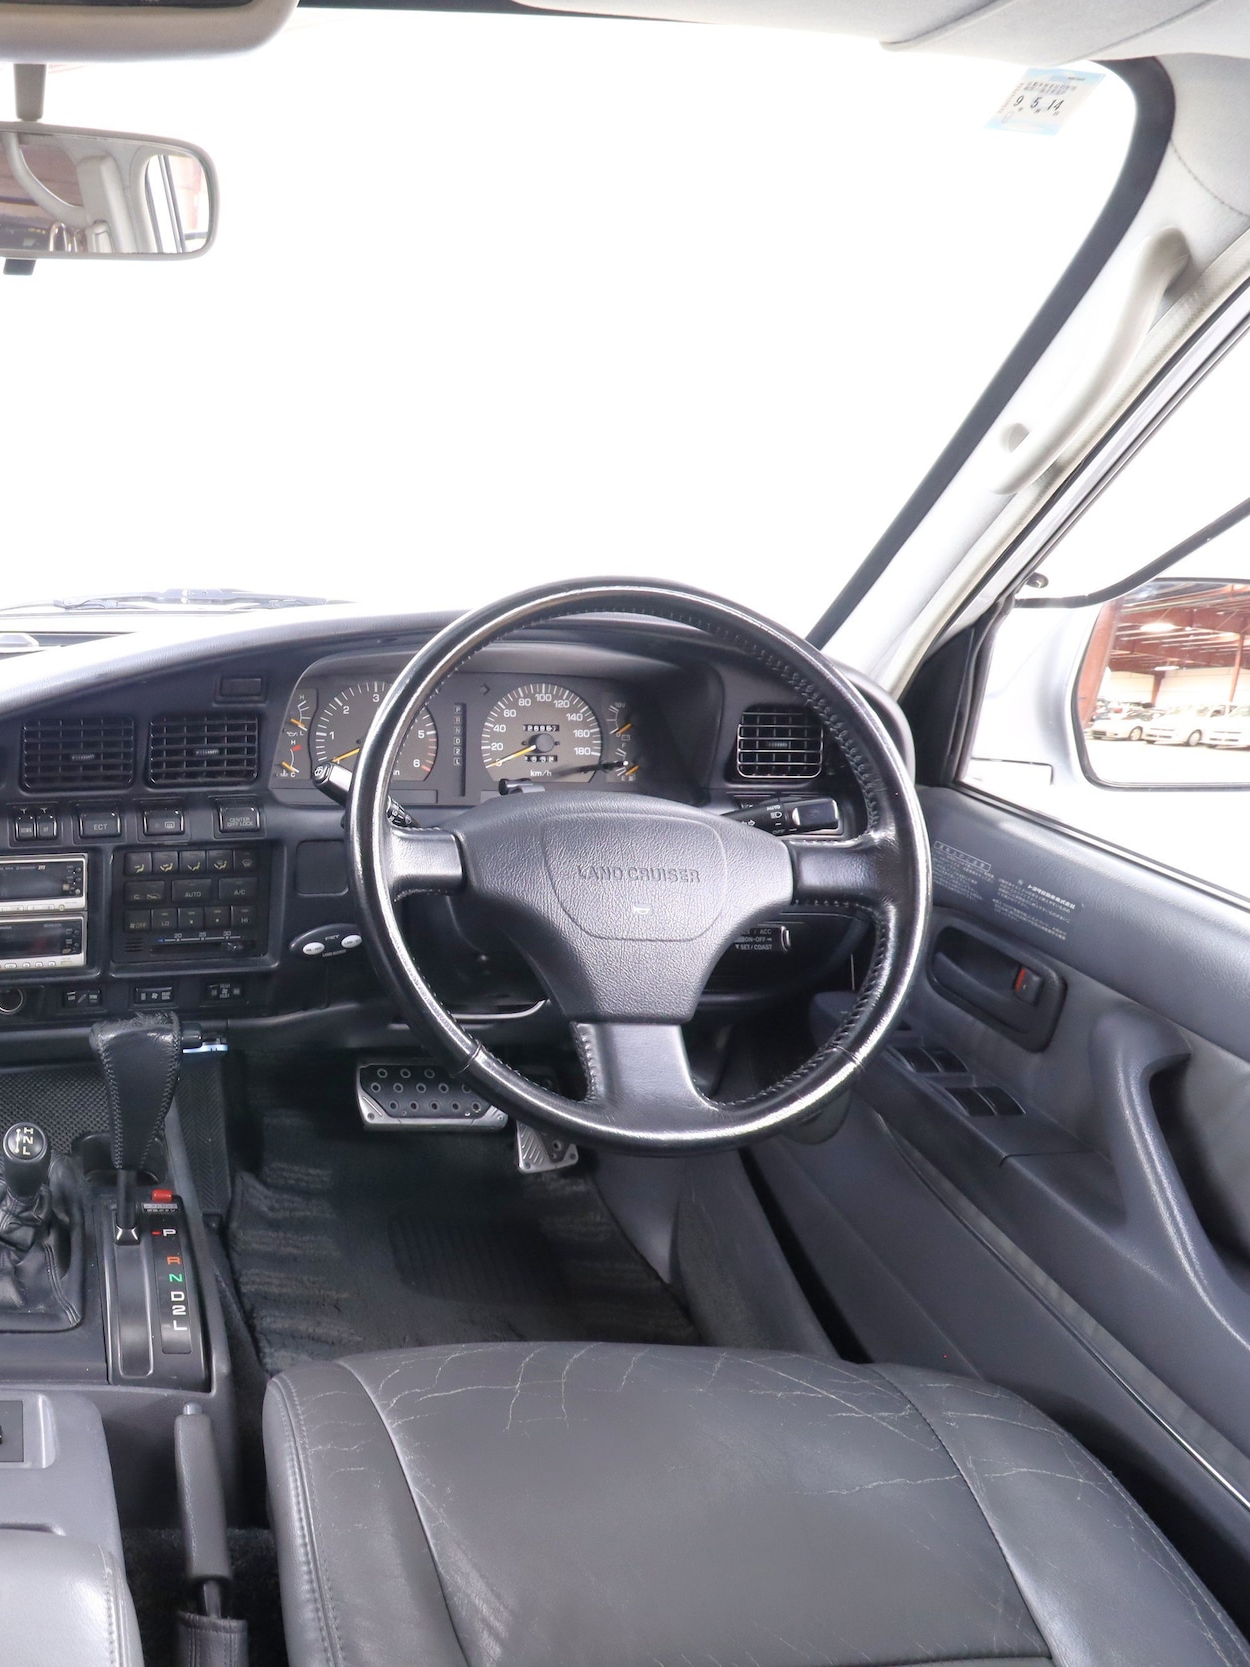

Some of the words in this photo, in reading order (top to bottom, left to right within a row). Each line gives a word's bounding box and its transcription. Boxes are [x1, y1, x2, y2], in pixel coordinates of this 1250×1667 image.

[1013, 95, 1024, 107] 9
[1030, 97, 1042, 109] 5
[1047, 99, 1064, 111] 14
[373, 693, 380, 702] 3
[535, 694, 552, 702] 100
[518, 699, 532, 707] 80
[553, 700, 570, 708] 120
[343, 706, 350, 715] 2
[504, 709, 517, 718] 60
[566, 713, 583, 722] 140
[493, 724, 507, 733] 40
[329, 732, 335, 740] 1
[418, 730, 425, 738] 5
[573, 729, 591, 738] 160
[491, 743, 503, 751] 20
[573, 747, 592, 756] 180
[413, 759, 421, 768] 6
[530, 769, 552, 777] km/h
[93, 823, 108, 831] ECT
[577, 865, 623, 881] LAND
[627, 867, 701, 883] CRUISER
[23, 1127, 34, 1135] H
[23, 1136, 34, 1145] N
[23, 1146, 31, 1156] L
[162, 1228, 176, 1237] P
[166, 1256, 181, 1265] R
[169, 1273, 183, 1283] N
[170, 1291, 185, 1301] D
[172, 1305, 187, 1315] 2
[173, 1320, 188, 1331] L
